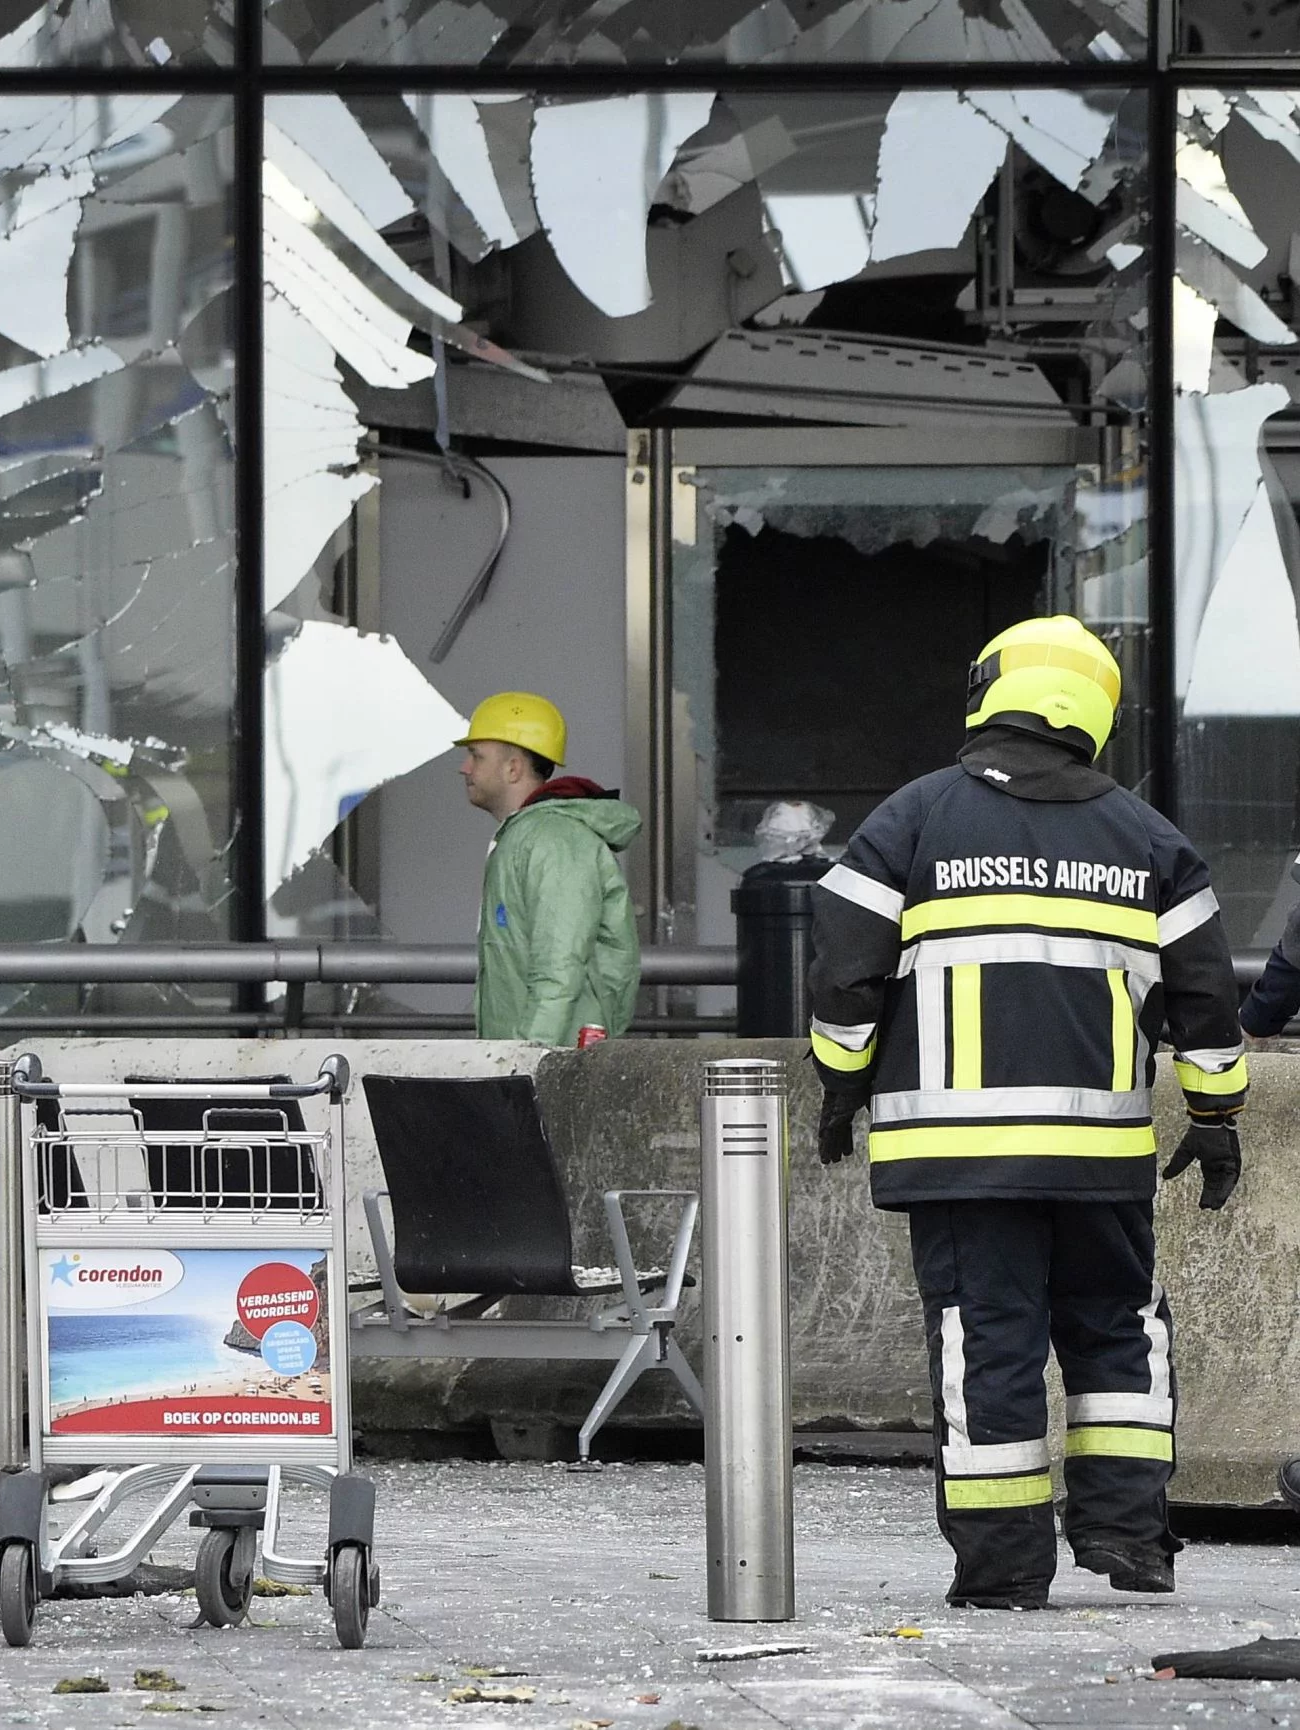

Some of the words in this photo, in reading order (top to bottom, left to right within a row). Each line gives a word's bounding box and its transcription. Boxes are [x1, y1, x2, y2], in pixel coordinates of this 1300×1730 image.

[935, 856, 1048, 890] BRUSSELS
[1054, 860, 1150, 900] AIRPORT
[78, 1265, 163, 1282] corendon
[239, 1290, 314, 1308] VERRASSEND
[245, 1303, 309, 1319] VOORDELIG
[163, 1412, 200, 1424] BOEK
[202, 1412, 221, 1424] OP
[223, 1412, 320, 1424] CORENDON.BE
